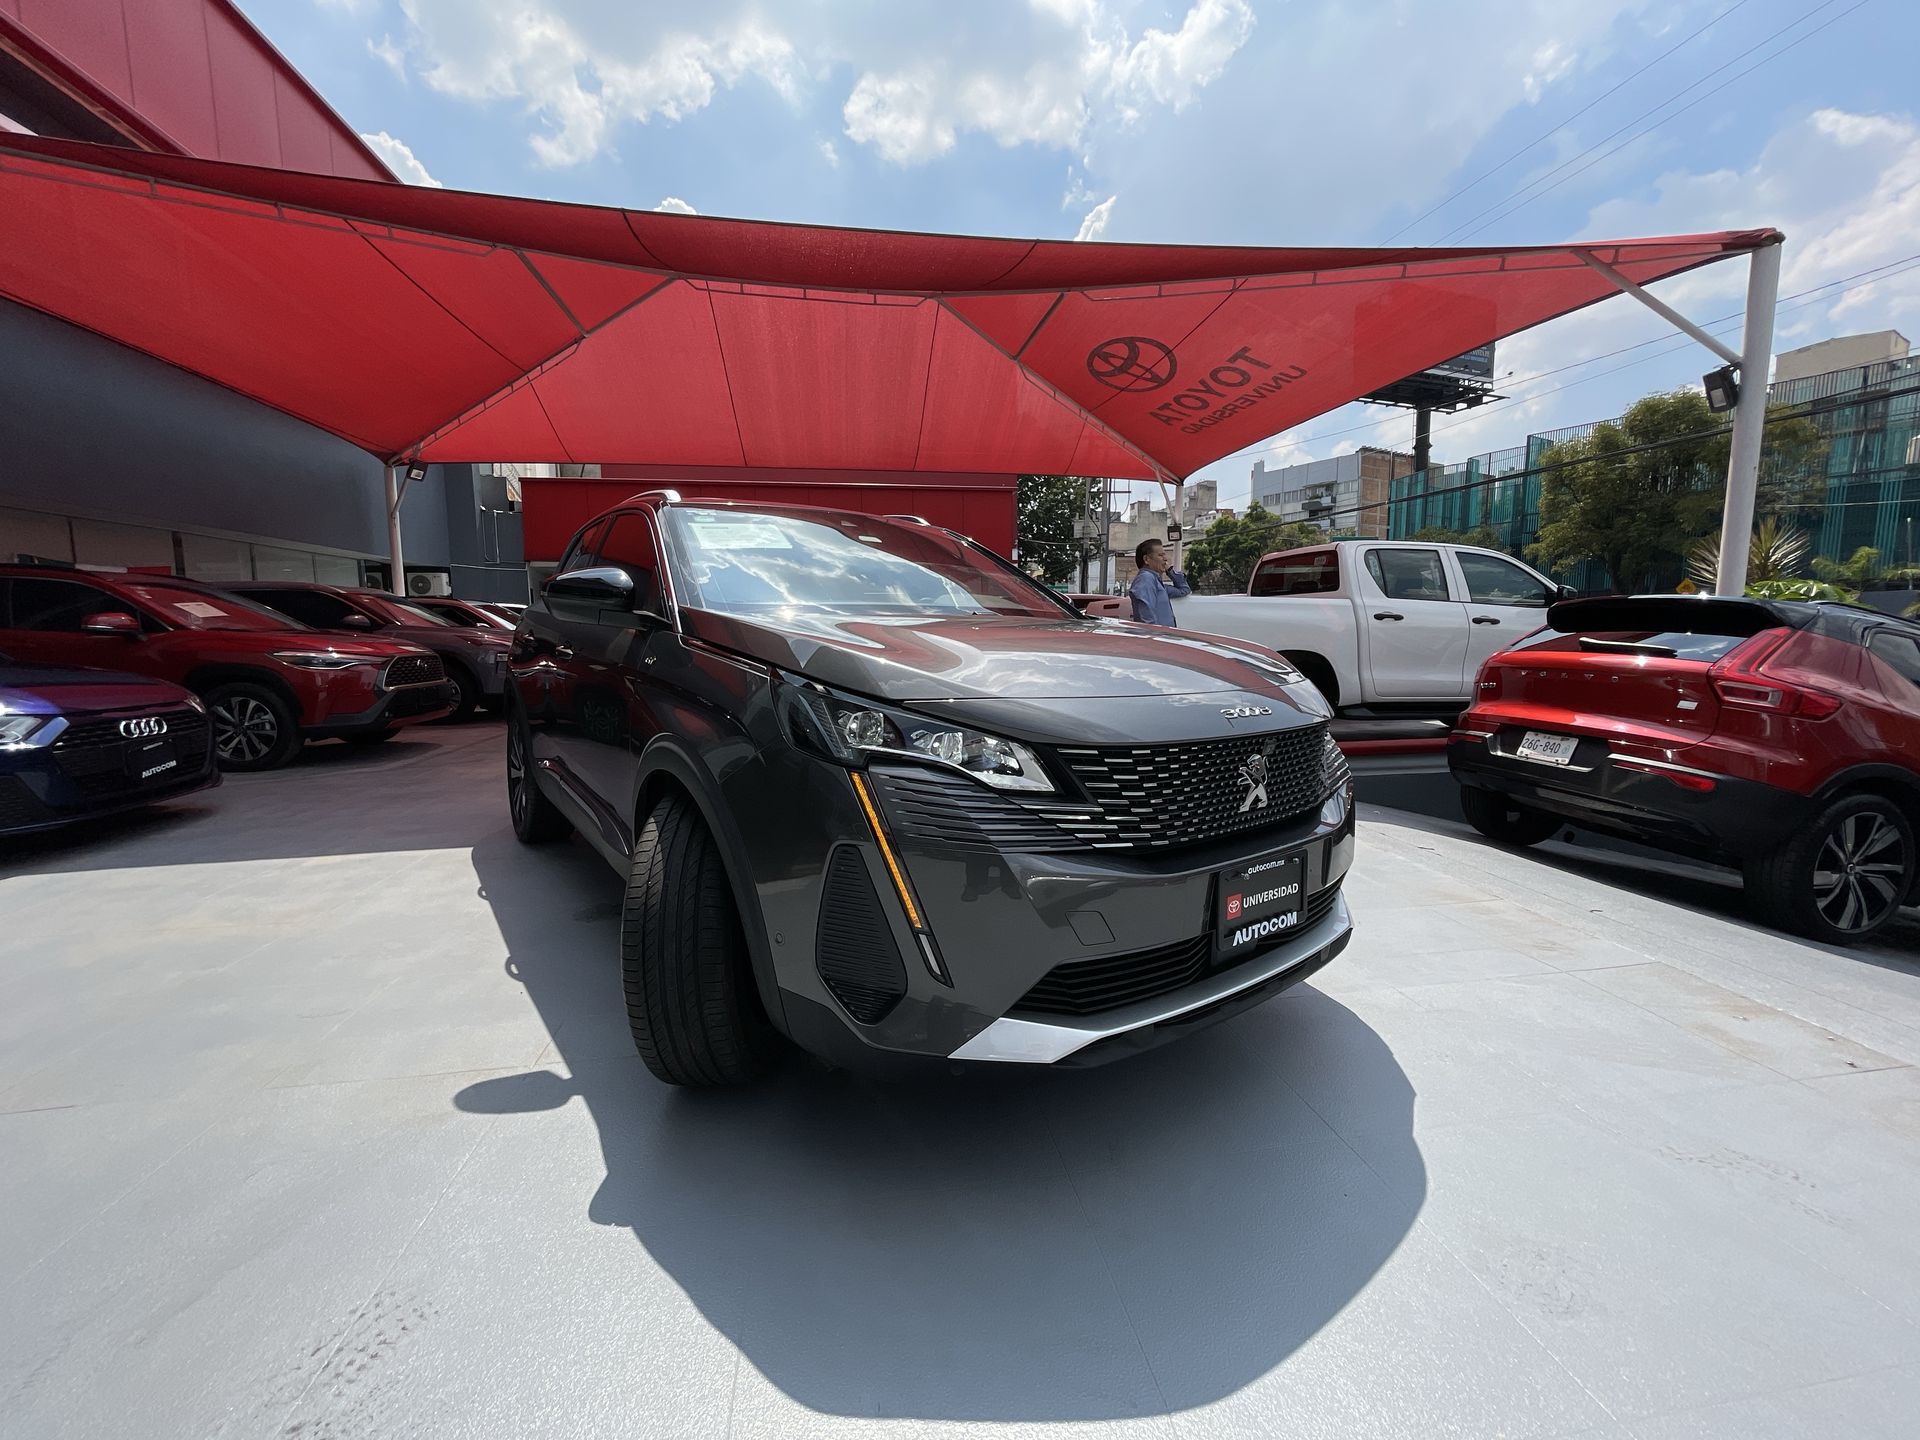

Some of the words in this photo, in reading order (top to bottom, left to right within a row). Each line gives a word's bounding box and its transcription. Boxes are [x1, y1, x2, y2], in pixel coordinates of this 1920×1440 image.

[142, 760, 177, 778] AUTOCOM
[1243, 883, 1299, 908] UNIVERSIDAD
[1232, 911, 1298, 947] AUTOCOM
